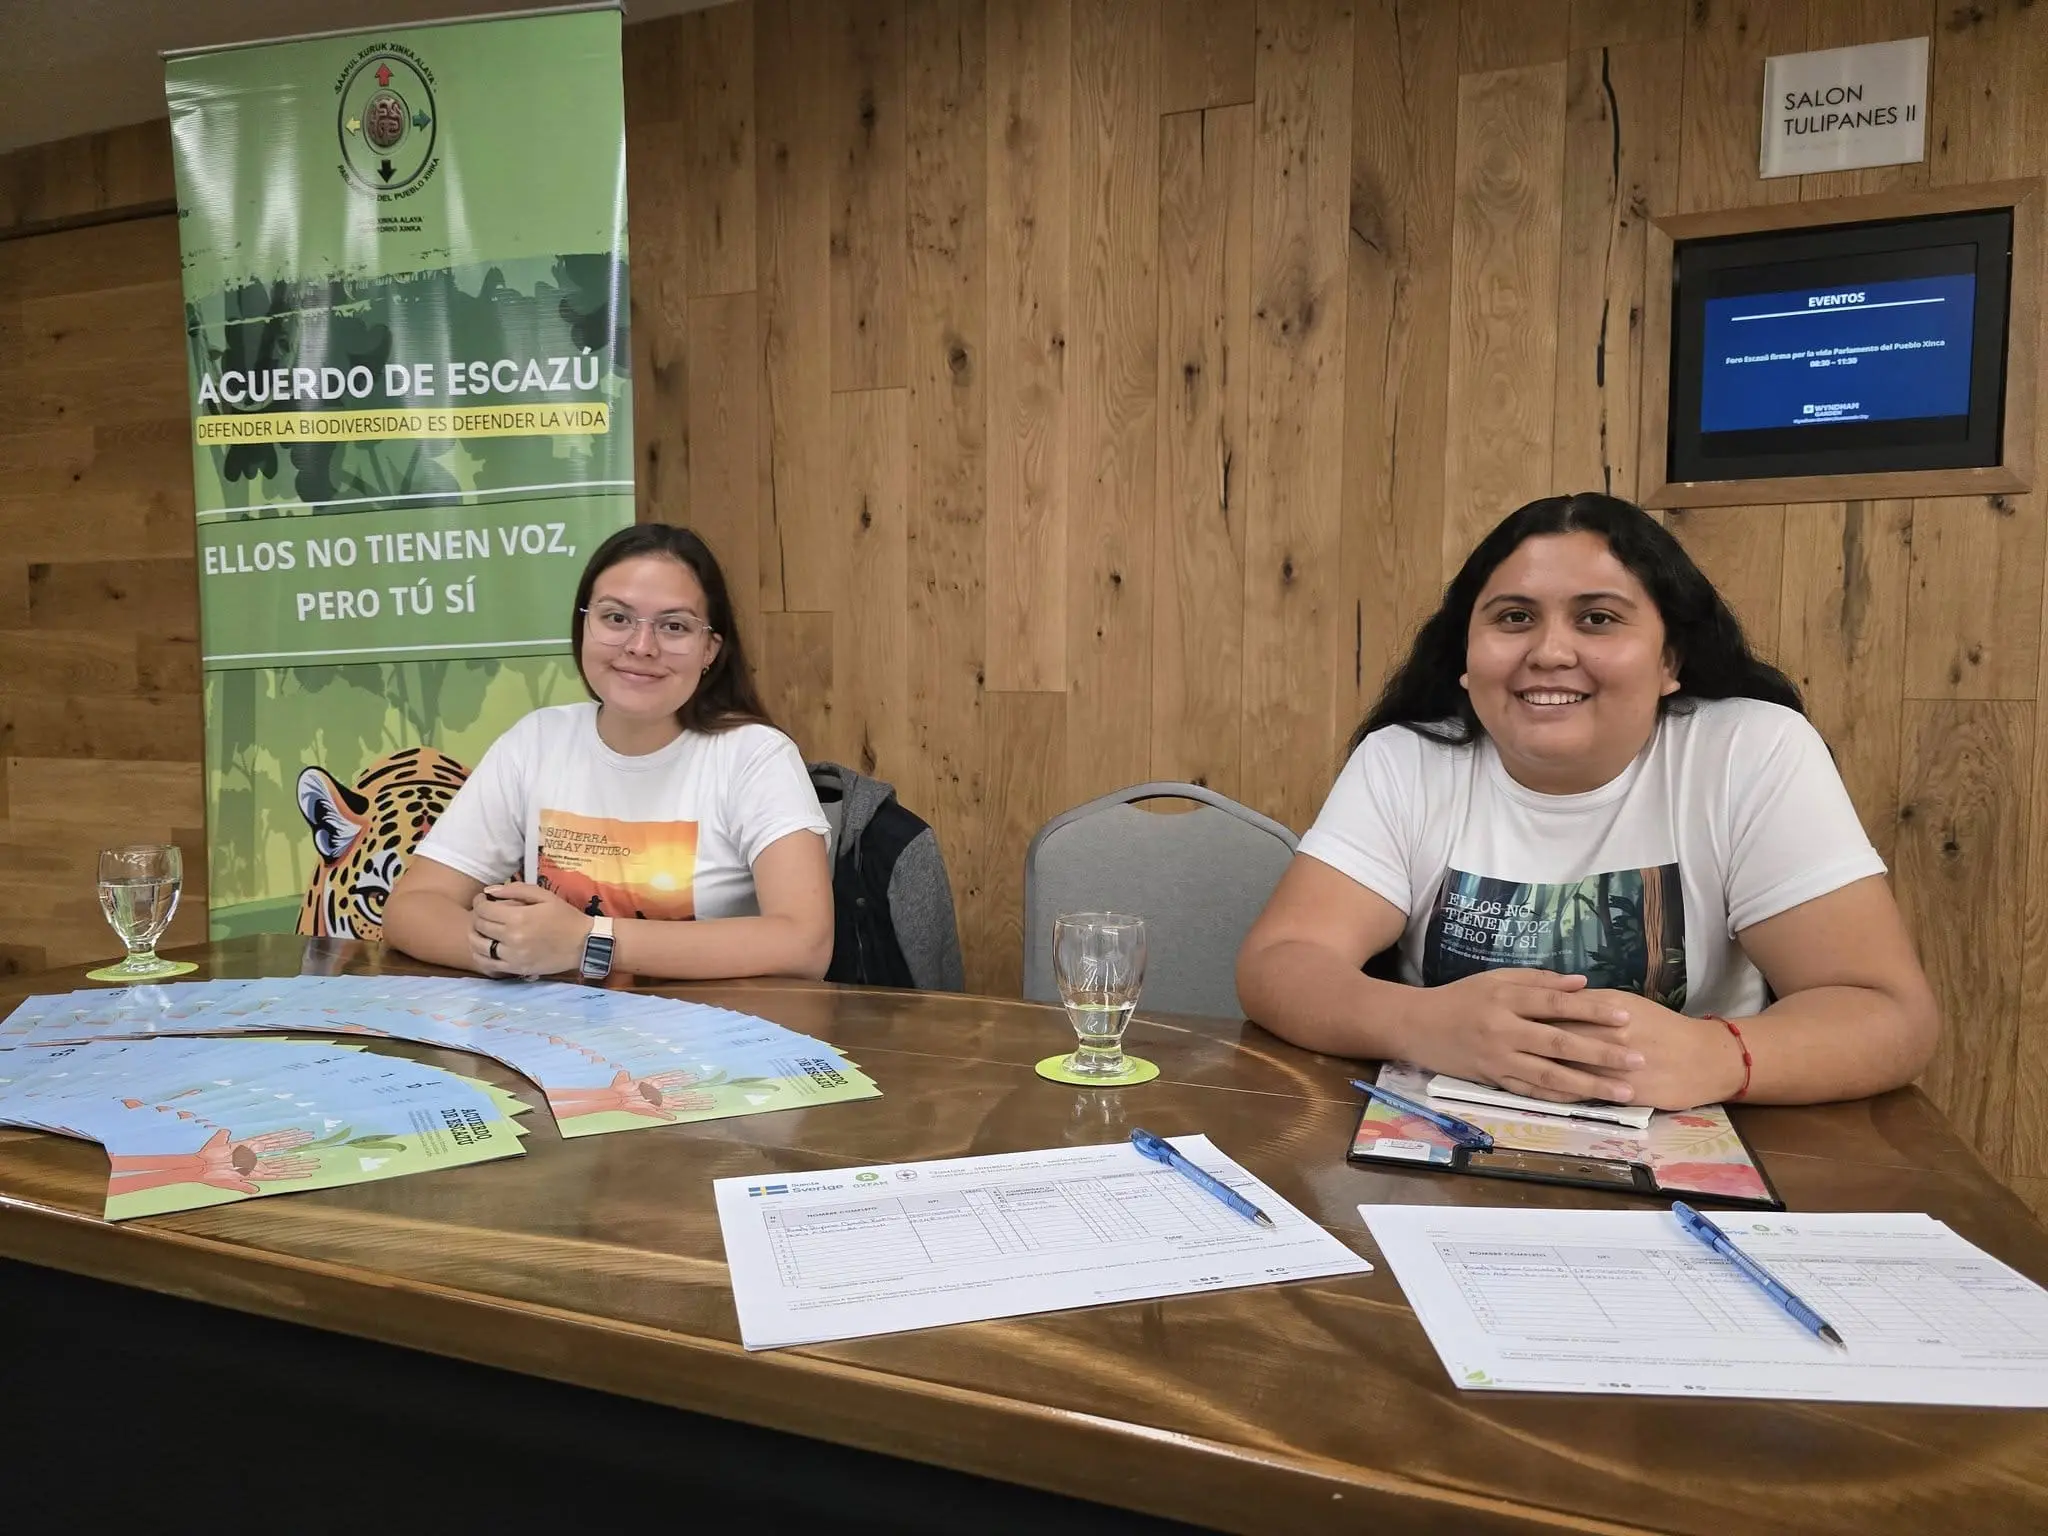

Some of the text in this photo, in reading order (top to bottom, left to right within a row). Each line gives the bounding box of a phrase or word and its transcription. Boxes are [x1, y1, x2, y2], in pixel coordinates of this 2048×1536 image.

[1784, 84, 1863, 111] SALON
[1784, 104, 1916, 135] TULIPANES II
[376, 193, 393, 202] DEL
[394, 179, 425, 200] PUEBLO
[1808, 292, 1865, 307] EVENTOS
[1833, 345, 1879, 356] Parlamento
[1880, 343, 1893, 352] del
[1894, 341, 1922, 351] Pueblo
[1922, 339, 1945, 348] Xinca
[198, 346, 600, 405] ACUERDO DE ESCAZÚ
[198, 407, 607, 439] DEFENDER LA BIODIVERSIDAD ES DEFENDER LA VIDA
[205, 522, 577, 576] ELLOS NO TIENEN VOZ,
[297, 575, 477, 622] PERO TÚ SÍ
[1447, 892, 1531, 918] ELLOS NO
[1445, 907, 1512, 931] TIENEN
[1443, 922, 1487, 944] PERO
[1491, 932, 1516, 948] TÚ
[1519, 932, 1538, 949] SÍ
[794, 1057, 811, 1067] DE
[812, 1058, 848, 1085] ACUERDO
[441, 1108, 478, 1145] DE ESCAZÚ
[461, 1109, 493, 1140] ACUERDO
